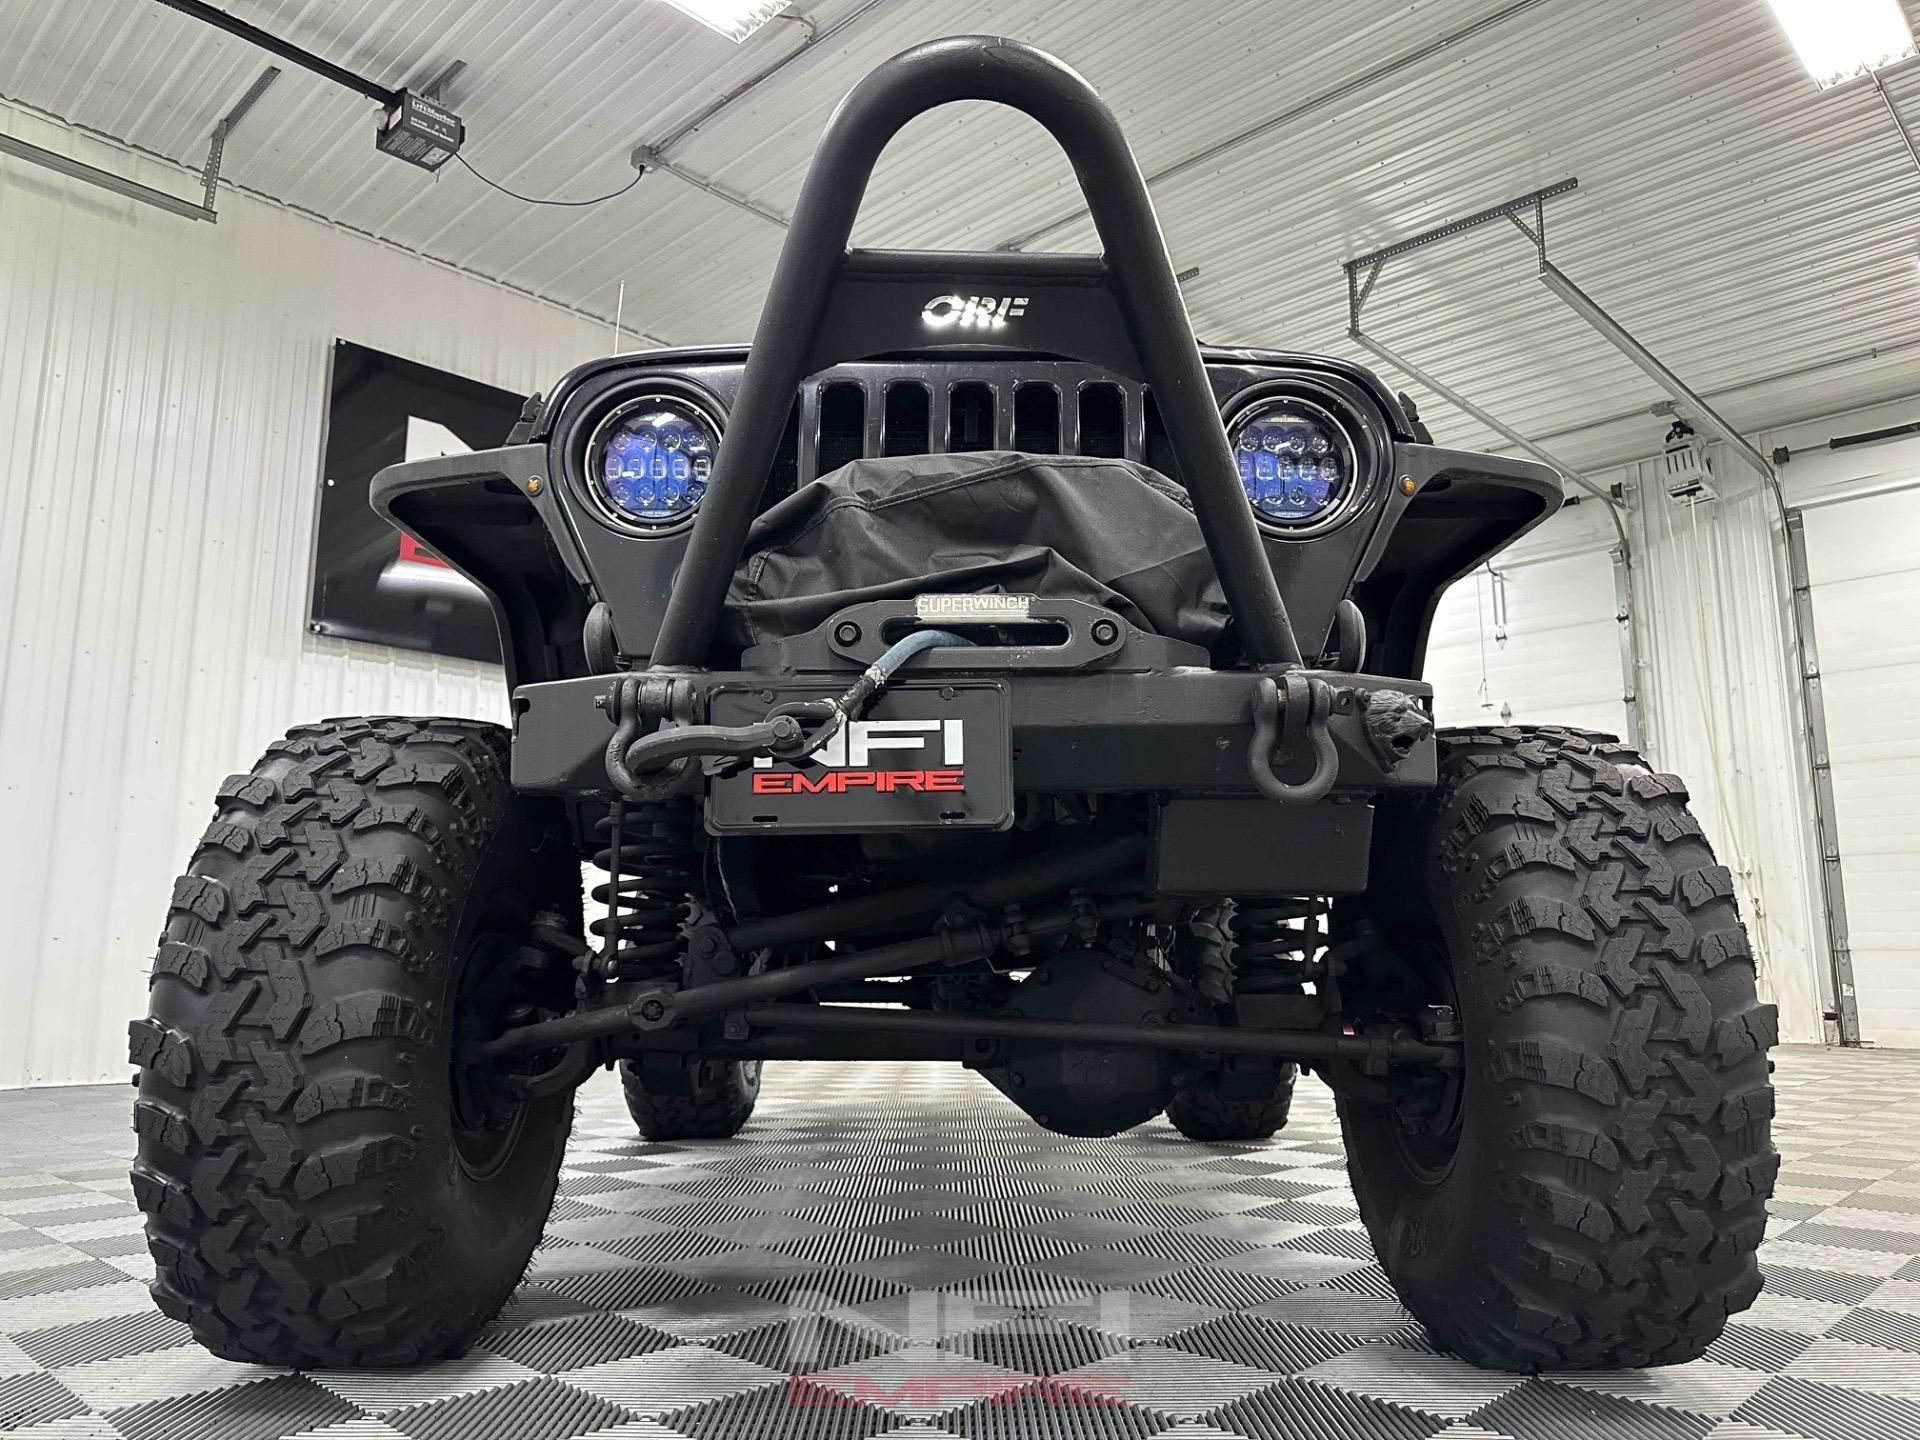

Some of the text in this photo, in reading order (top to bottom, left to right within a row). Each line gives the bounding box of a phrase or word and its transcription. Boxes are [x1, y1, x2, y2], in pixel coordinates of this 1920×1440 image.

[922, 296, 1029, 327] ORF
[916, 596, 1030, 613] SUPERWINCH
[753, 770, 964, 794] EMPIRE
